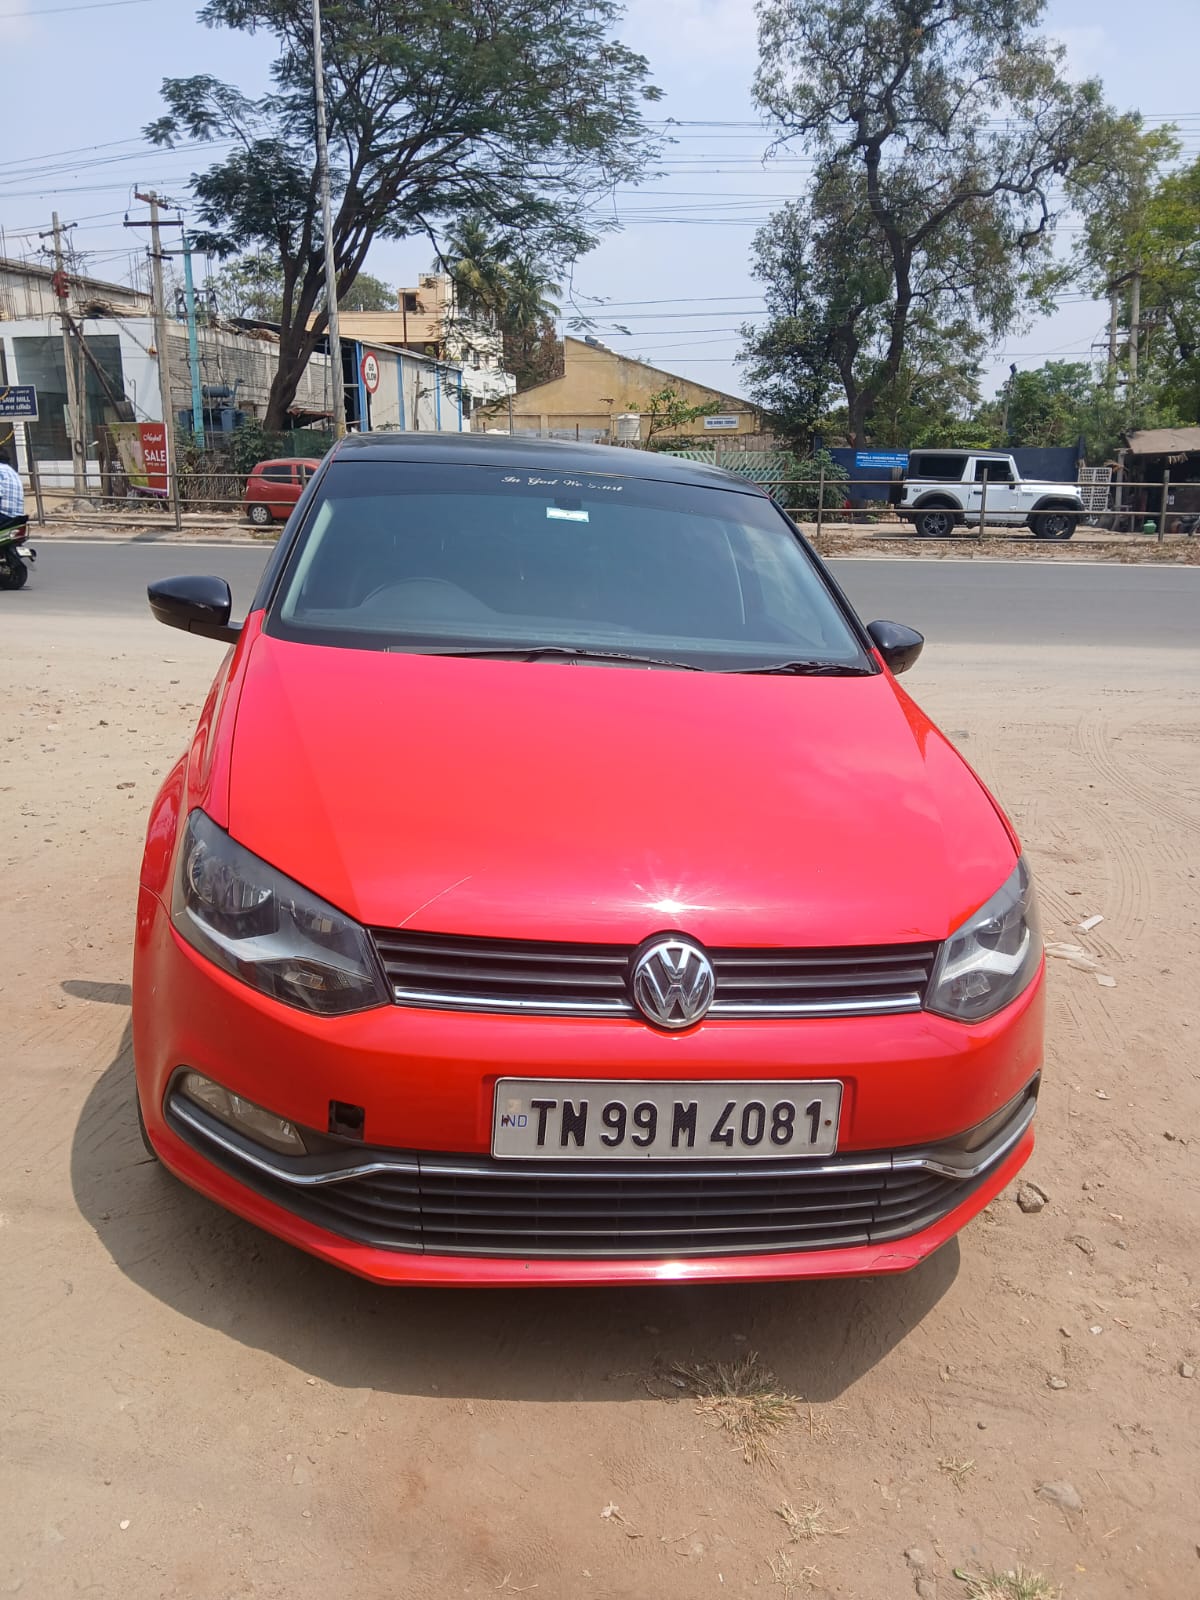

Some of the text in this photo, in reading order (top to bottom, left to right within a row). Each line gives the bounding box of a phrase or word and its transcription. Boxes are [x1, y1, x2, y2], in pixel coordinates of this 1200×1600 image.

[368, 363, 374, 371] GO
[366, 372, 377, 380] SLOW
[16, 395, 31, 403] MILL
[144, 449, 166, 462] SALE
[527, 477, 558, 486] God
[563, 479, 583, 487] We
[587, 483, 623, 491] Tust
[500, 1114, 528, 1127] IND
[531, 1100, 822, 1147] TN 99 M 4081
